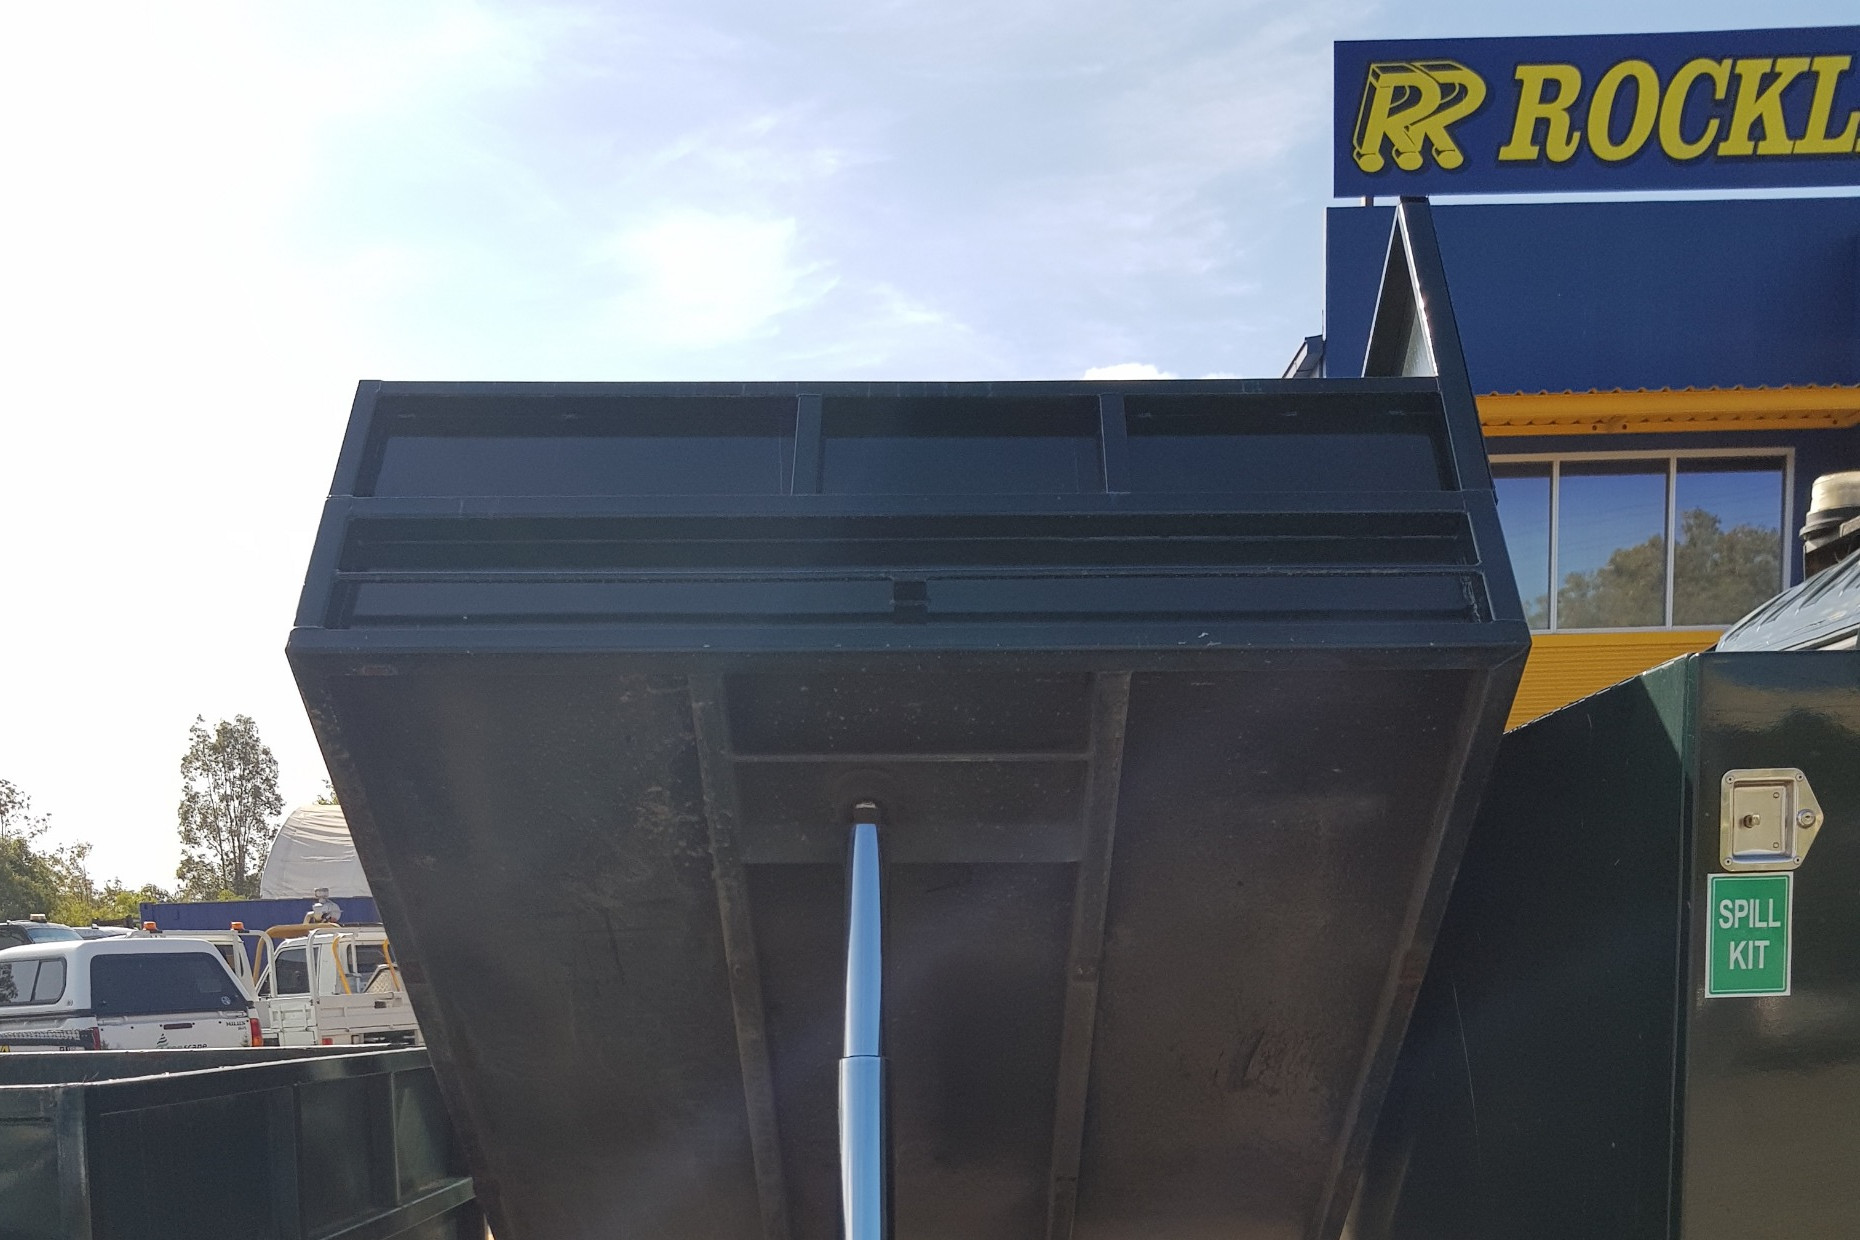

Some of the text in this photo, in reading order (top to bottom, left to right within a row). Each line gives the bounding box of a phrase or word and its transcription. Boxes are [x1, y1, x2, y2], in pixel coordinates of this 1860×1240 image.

[1499, 55, 1860, 163] ROCKL
[1718, 899, 1781, 929] SPILL
[1729, 940, 1770, 970] KIT
